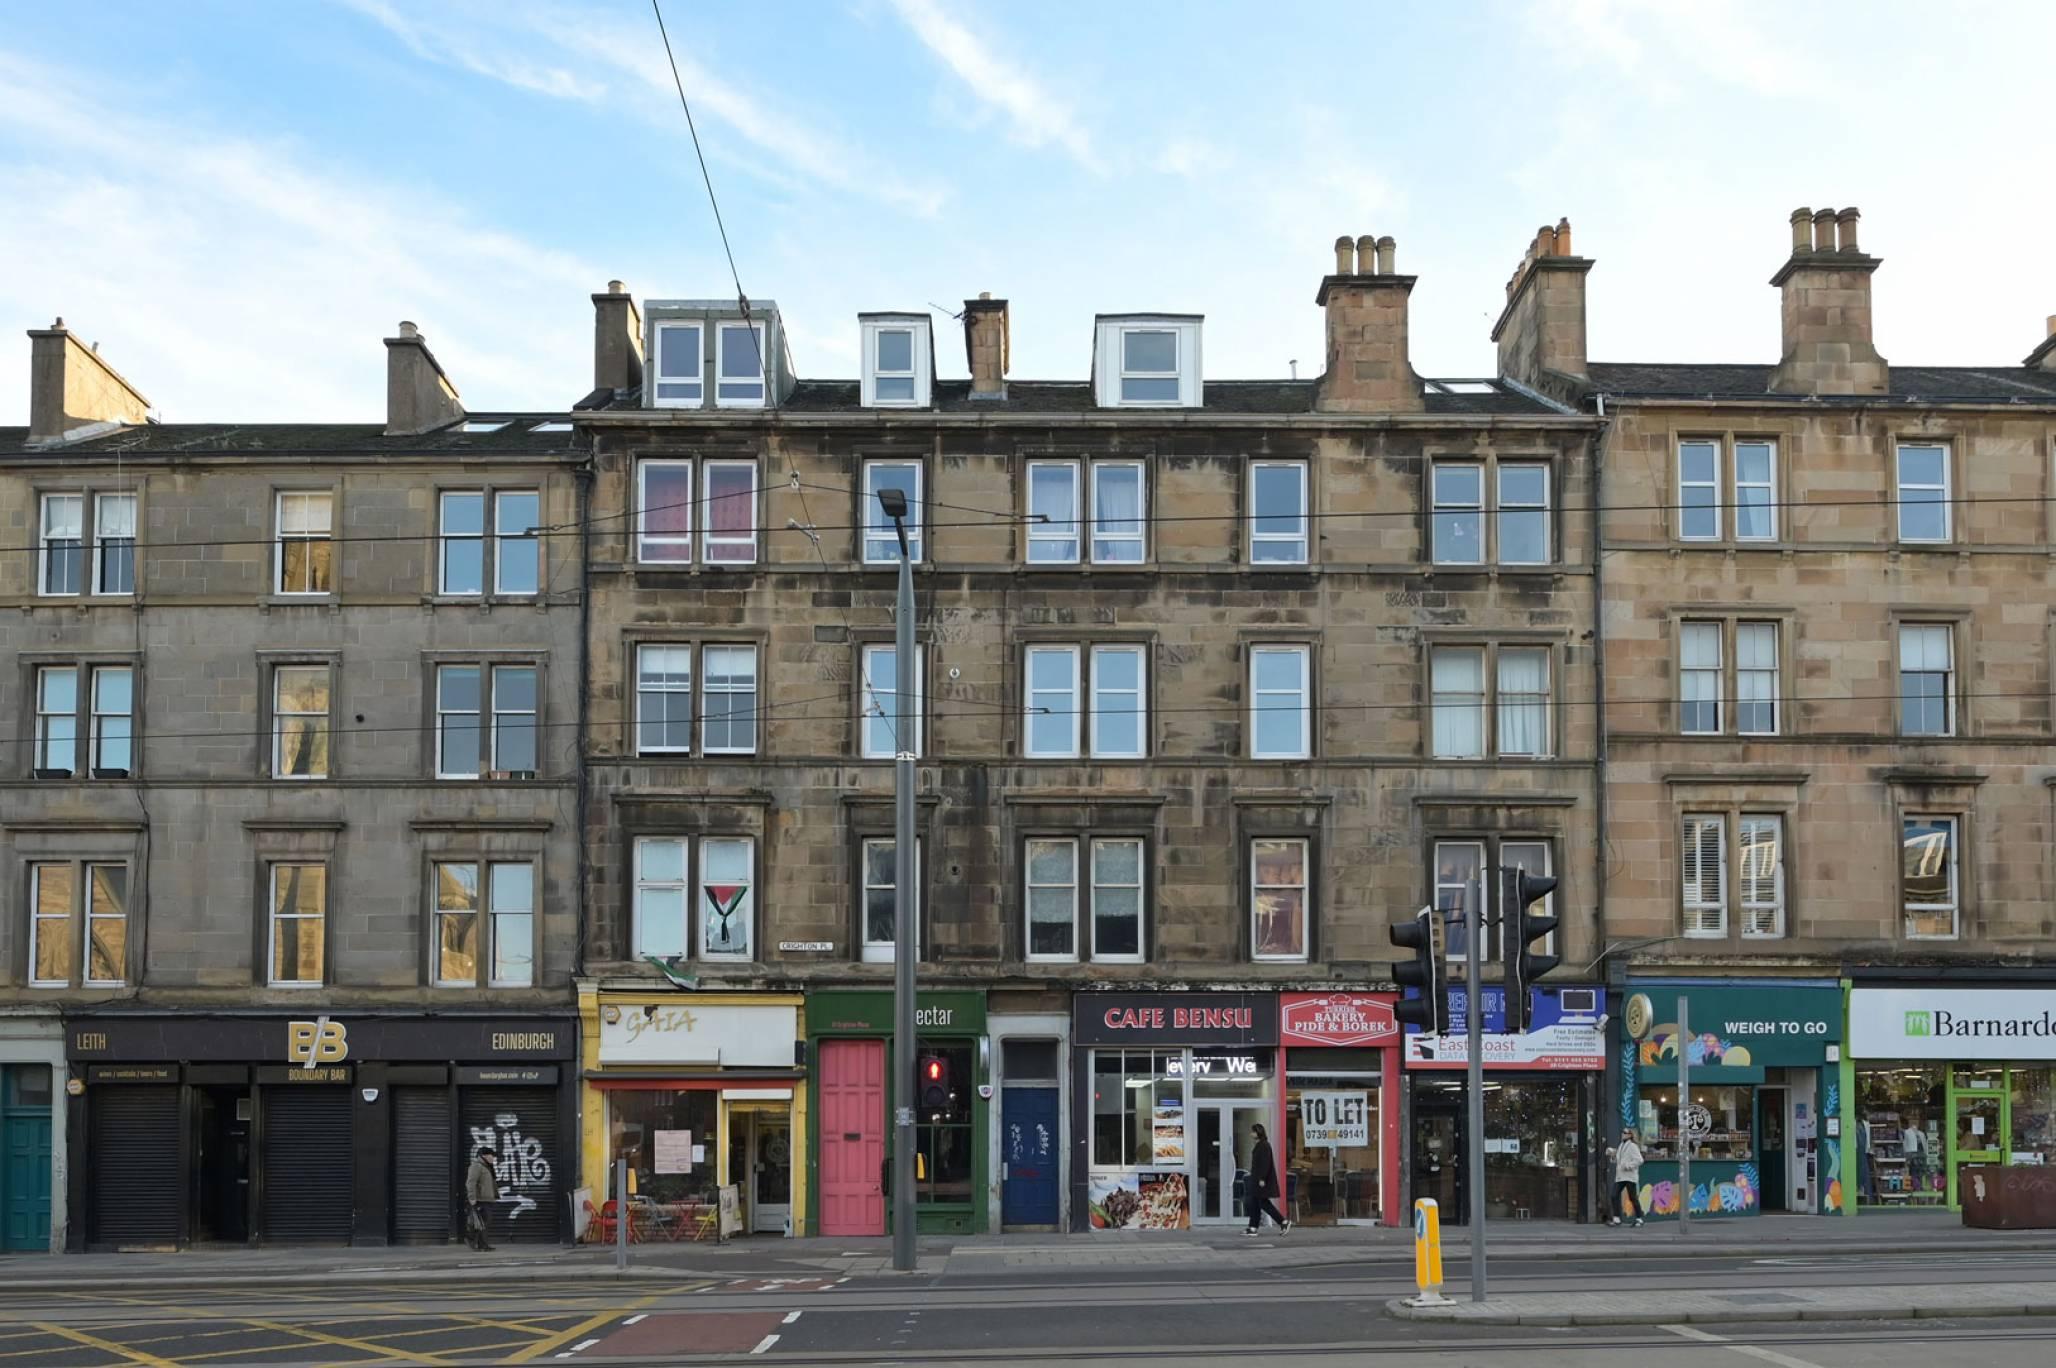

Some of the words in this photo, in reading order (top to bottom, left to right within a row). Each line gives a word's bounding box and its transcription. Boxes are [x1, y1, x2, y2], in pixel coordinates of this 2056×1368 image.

[916, 1005, 952, 1025] ectar
[1105, 1008, 1165, 1028] CAFE
[1174, 1008, 1252, 1028] BENSU
[1314, 1013, 1366, 1022] BAKERY
[626, 1010, 697, 1044] GAIA
[1295, 1022, 1325, 1031] PIDE
[1328, 1022, 1338, 1031] &
[1725, 1022, 1775, 1034] WEIGH
[1779, 1022, 1800, 1034] TO
[1804, 1022, 1827, 1034] GO
[77, 1033, 106, 1050] LEITH
[492, 1033, 555, 1050] EDINBURGH
[289, 1069, 327, 1080] BOUNDARY
[331, 1069, 345, 1080] BAR
[1304, 1099, 1326, 1125] TO
[1334, 1098, 1364, 1125] LET
[1305, 1129, 1364, 1139] 073949141
